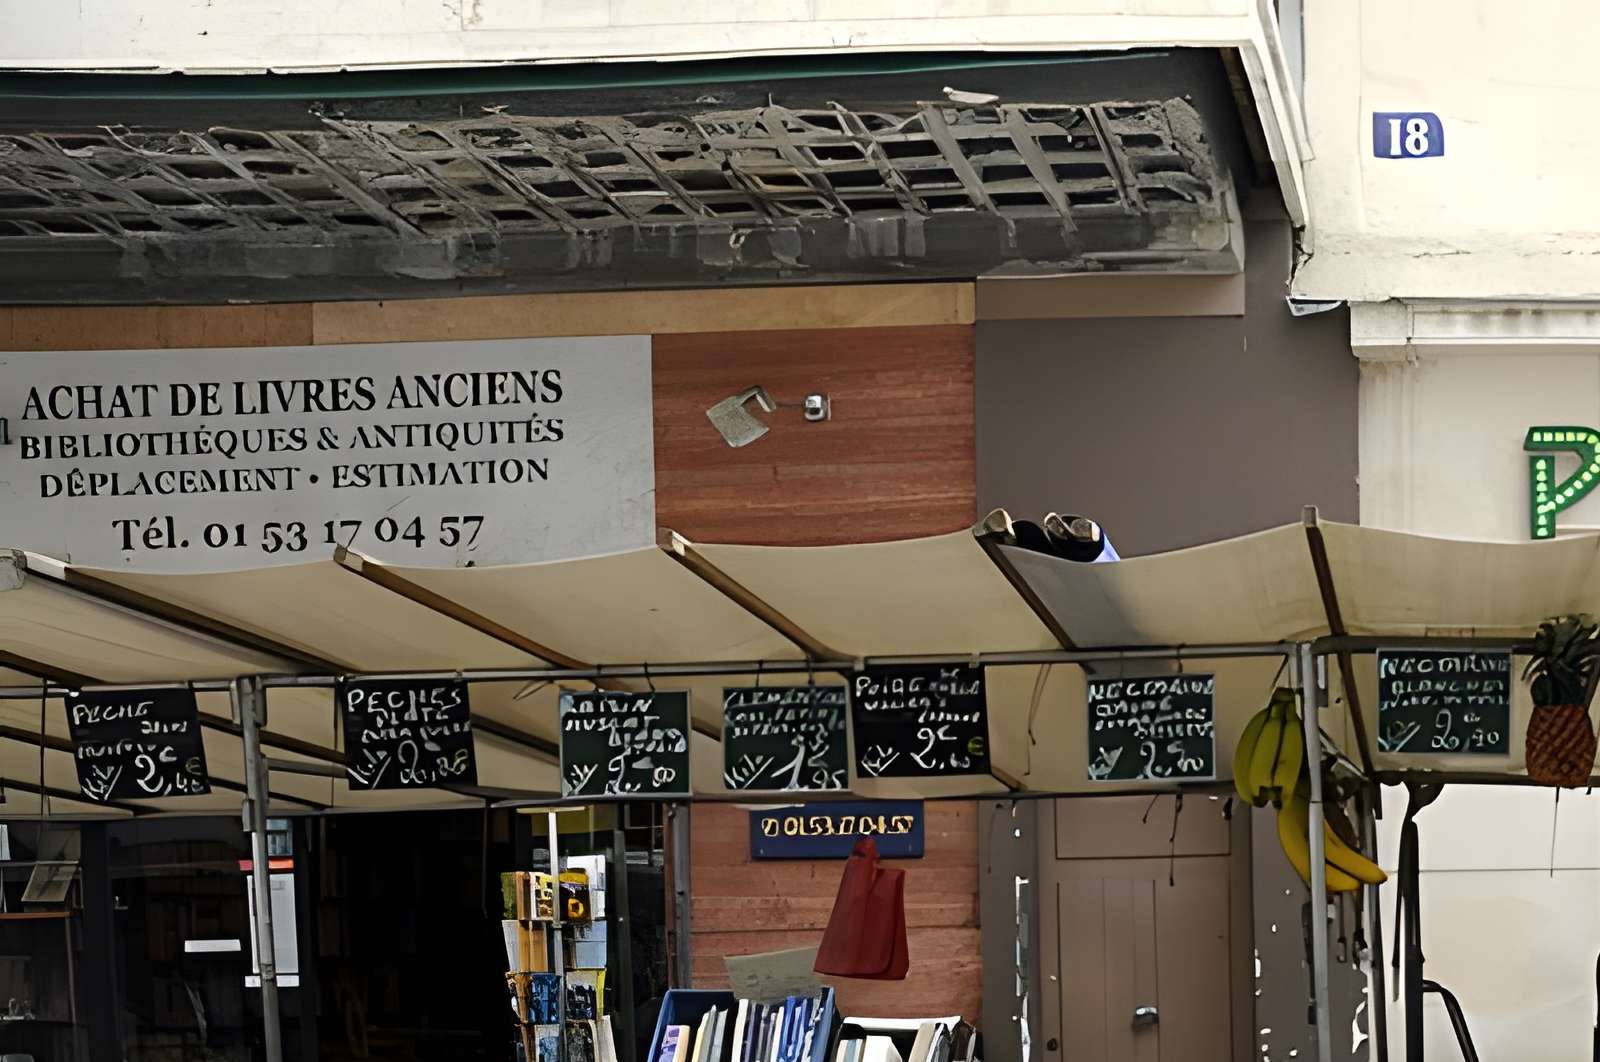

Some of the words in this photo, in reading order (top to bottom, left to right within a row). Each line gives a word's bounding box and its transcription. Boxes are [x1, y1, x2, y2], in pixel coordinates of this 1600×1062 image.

[1388, 117, 1430, 156] 18
[21, 384, 158, 420] ACHAT
[169, 381, 222, 417] DE
[232, 376, 376, 415] LIVRES
[386, 369, 564, 409] ANCIENS
[316, 426, 340, 451] &
[350, 412, 564, 451] ANTIQUITÉS
[332, 457, 549, 488] ESTIMATION
[111, 515, 189, 550] Tél.
[203, 522, 248, 548] 01
[261, 521, 308, 553] 53
[323, 519, 362, 548] 17
[374, 515, 426, 548] 04
[439, 515, 485, 551] 57
